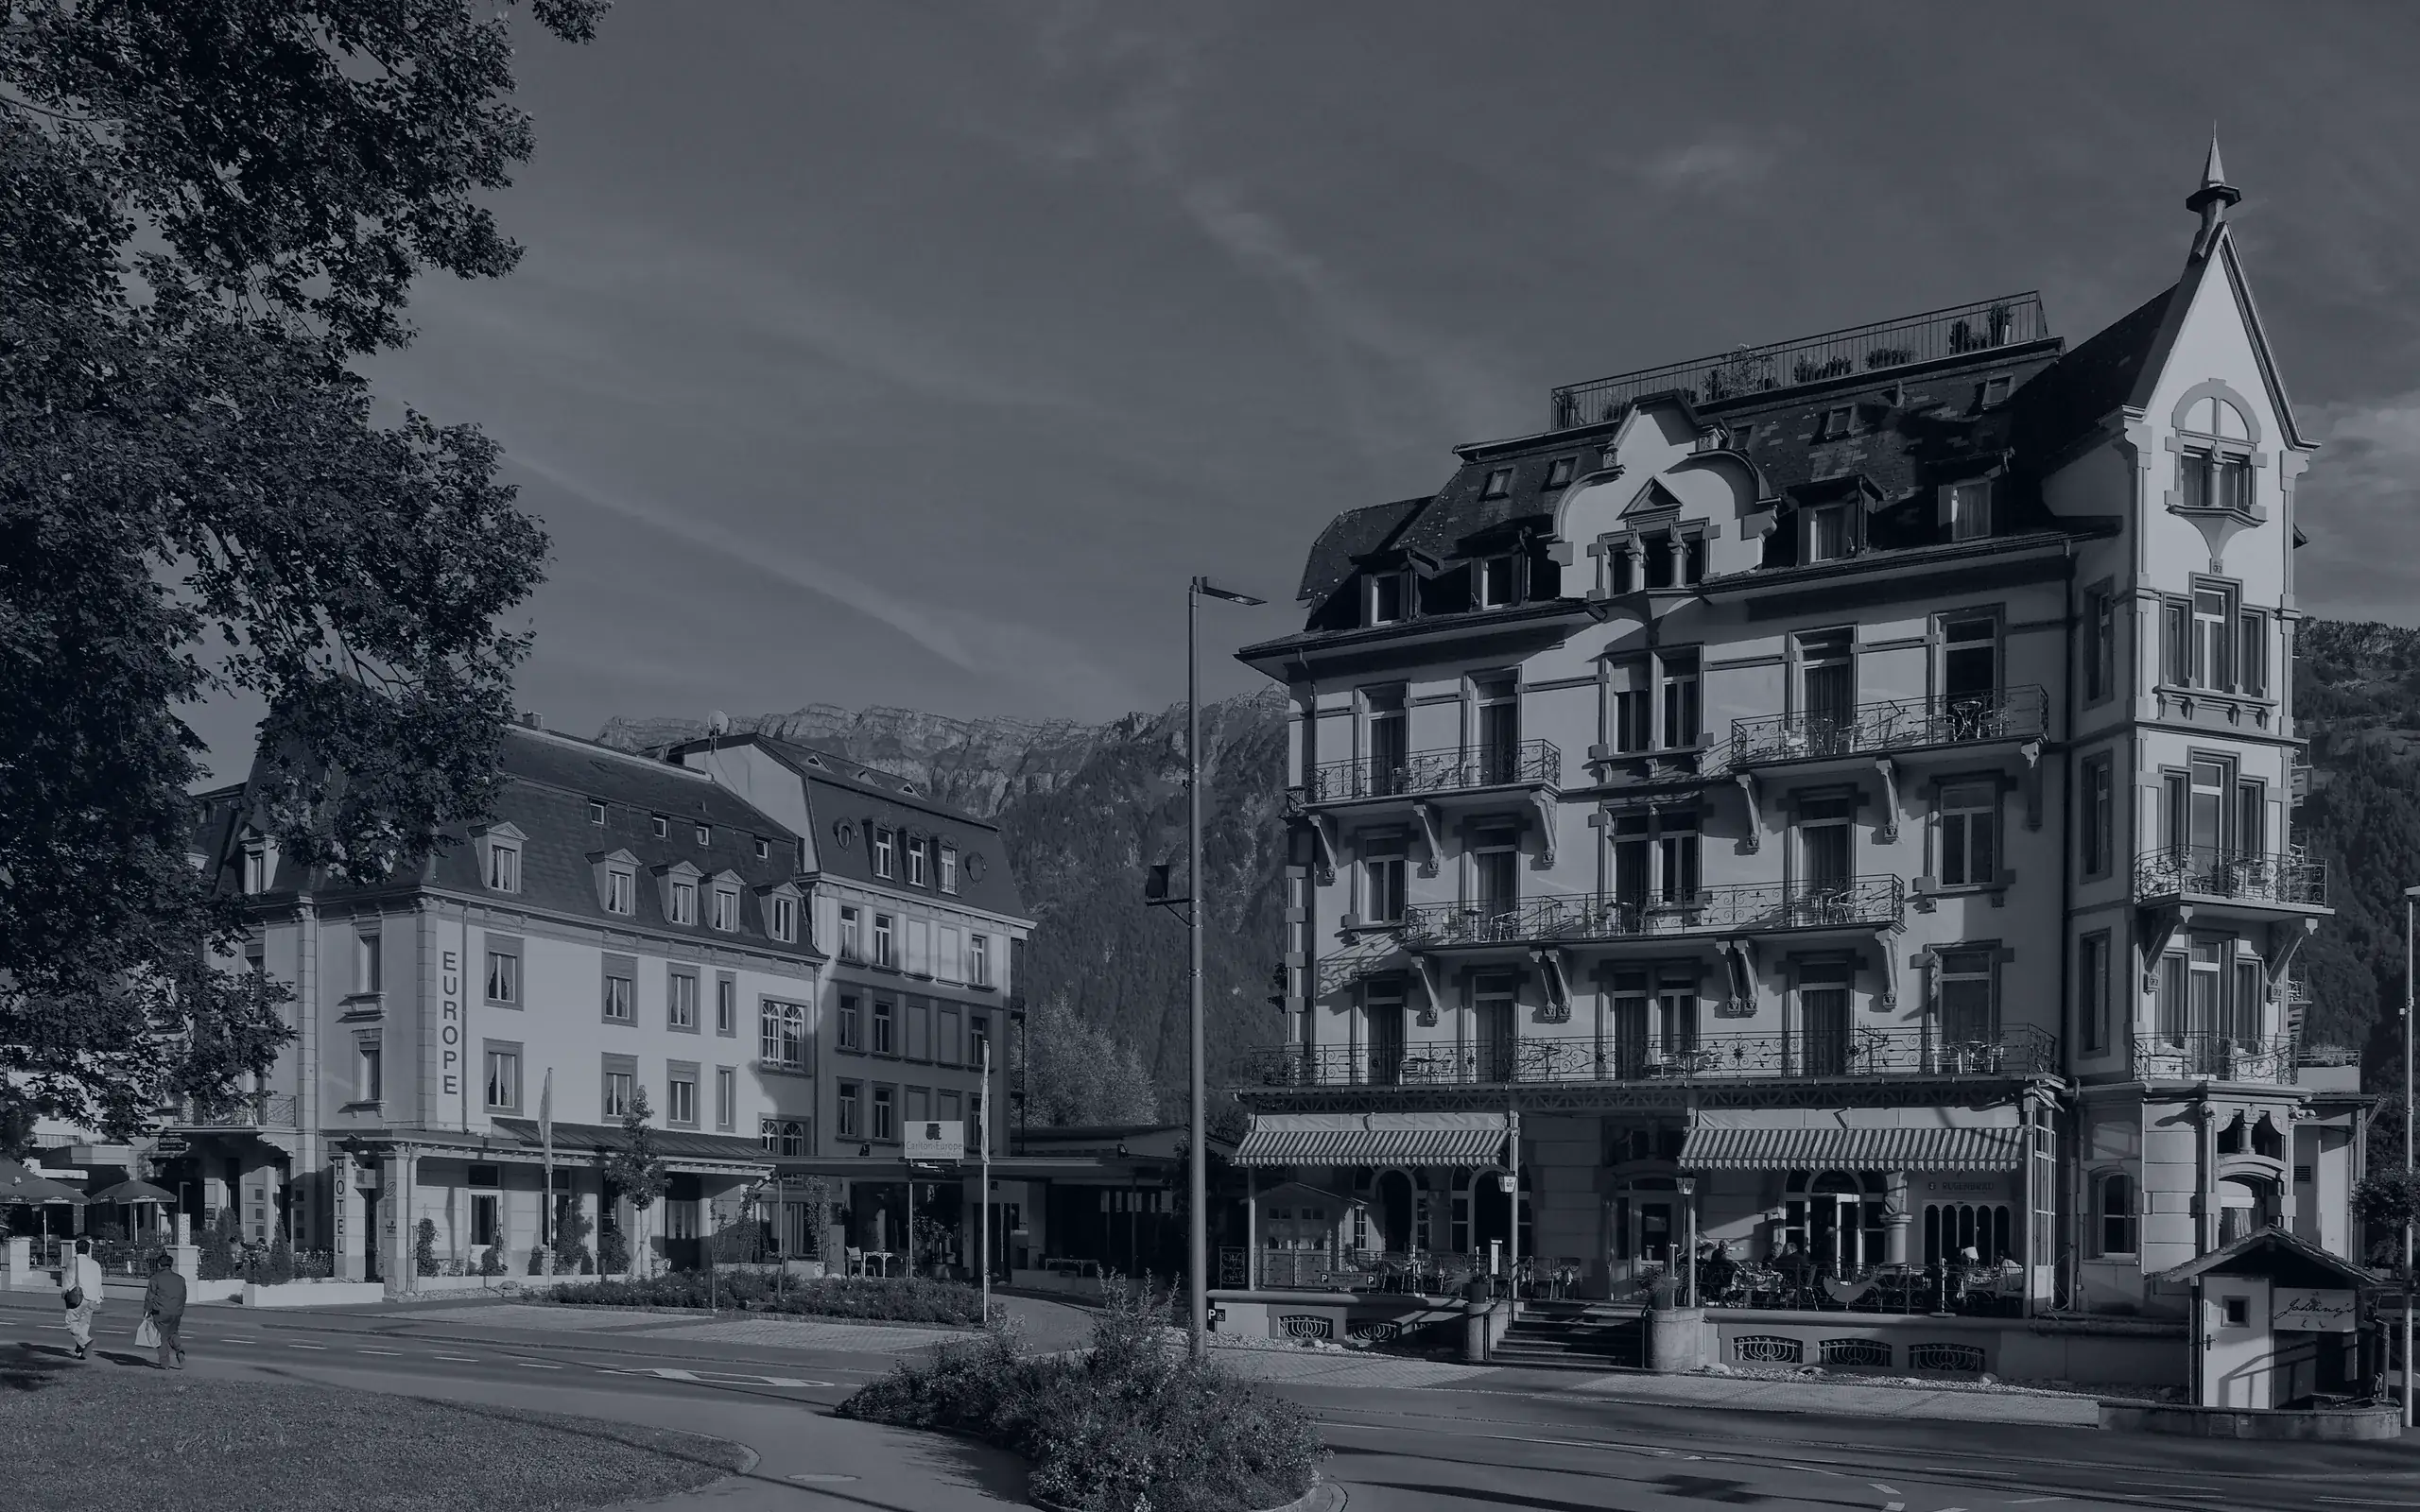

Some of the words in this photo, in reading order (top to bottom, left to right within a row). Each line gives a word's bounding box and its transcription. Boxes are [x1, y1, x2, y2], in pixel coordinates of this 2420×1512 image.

[442, 951, 458, 1094] EUROPE
[336, 1160, 345, 1254] HOTEL
[1322, 1274, 1328, 1283] P
[1368, 1276, 1374, 1284] P
[1208, 1309, 1217, 1320] P
